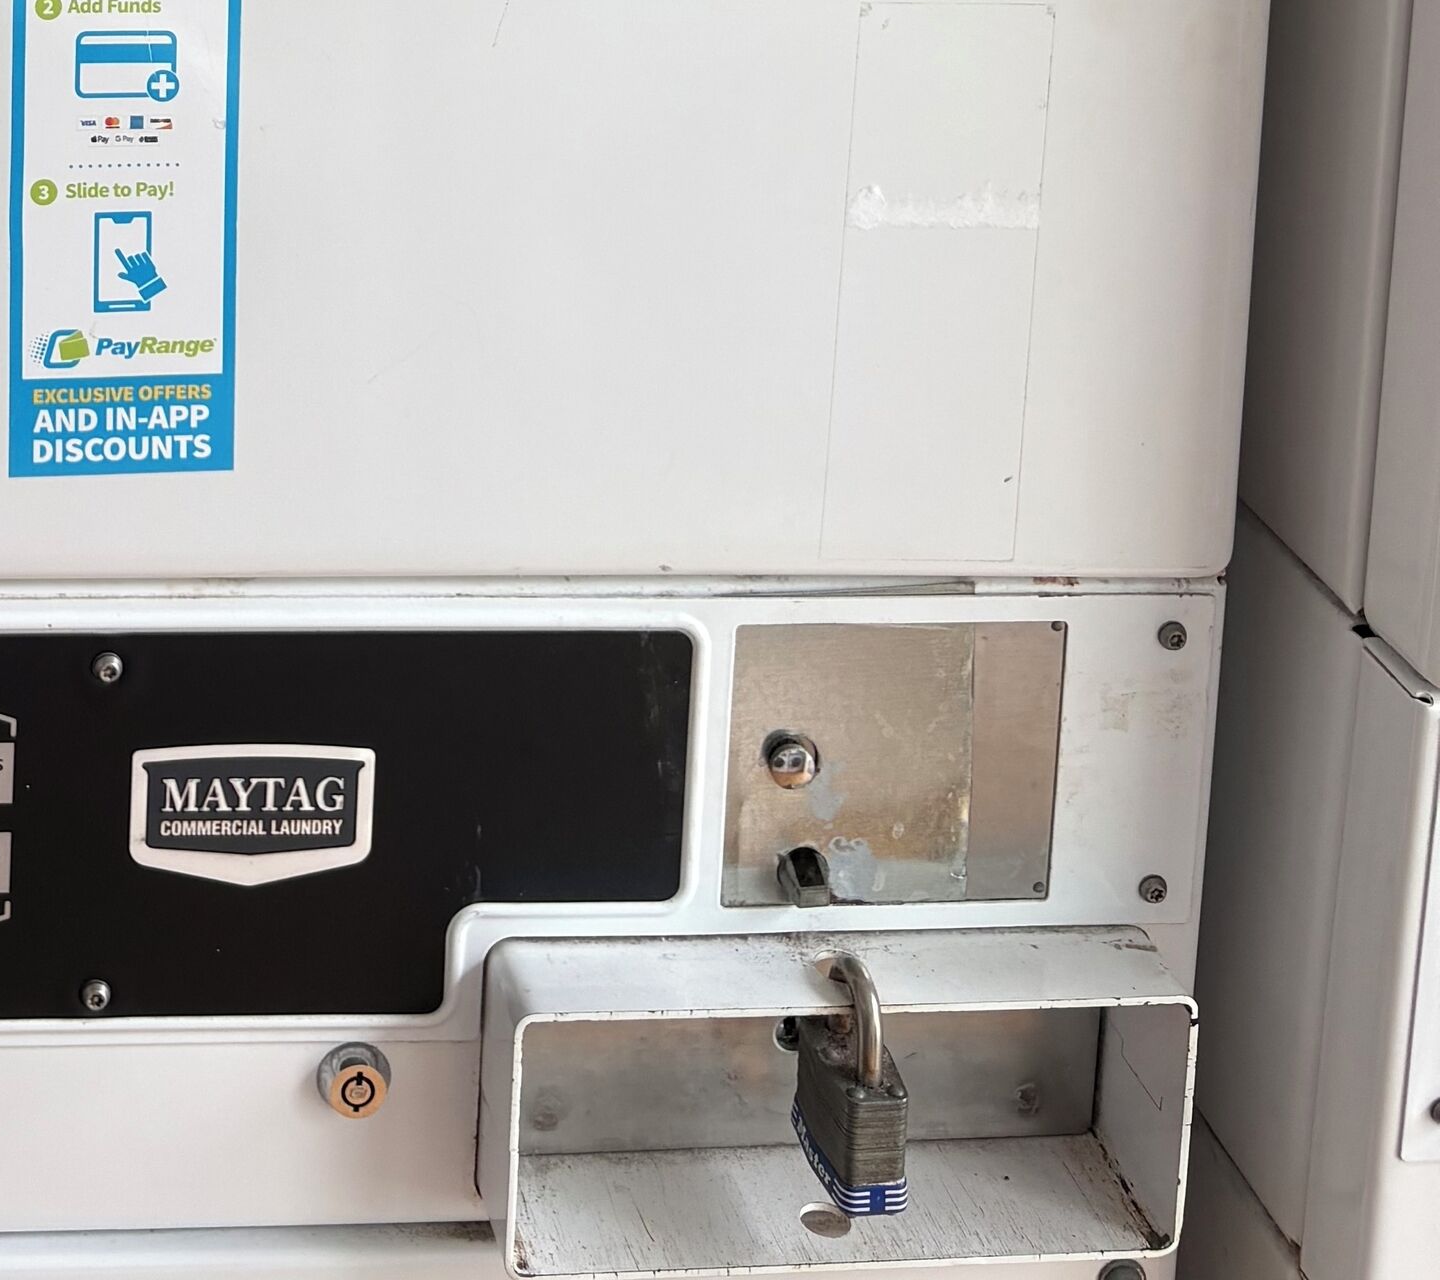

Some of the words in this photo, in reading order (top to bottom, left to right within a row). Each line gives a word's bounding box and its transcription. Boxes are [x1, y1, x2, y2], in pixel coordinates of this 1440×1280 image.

[98, 136, 109, 144] Pay
[66, 182, 109, 199] Slide
[113, 183, 131, 198] to
[135, 181, 175, 201] Pay!
[95, 337, 214, 359] PayRange
[32, 387, 133, 404] EXCLUSIVE
[139, 384, 212, 401] OFFERS
[33, 408, 98, 433] AND
[106, 405, 210, 431] IN-APP
[32, 434, 211, 463] DISCOUNTS
[161, 777, 344, 812] MAYTAG
[160, 820, 266, 836] COMMERCIAL
[271, 819, 343, 835] LAUNDRY
[797, 1116, 831, 1184] Master
